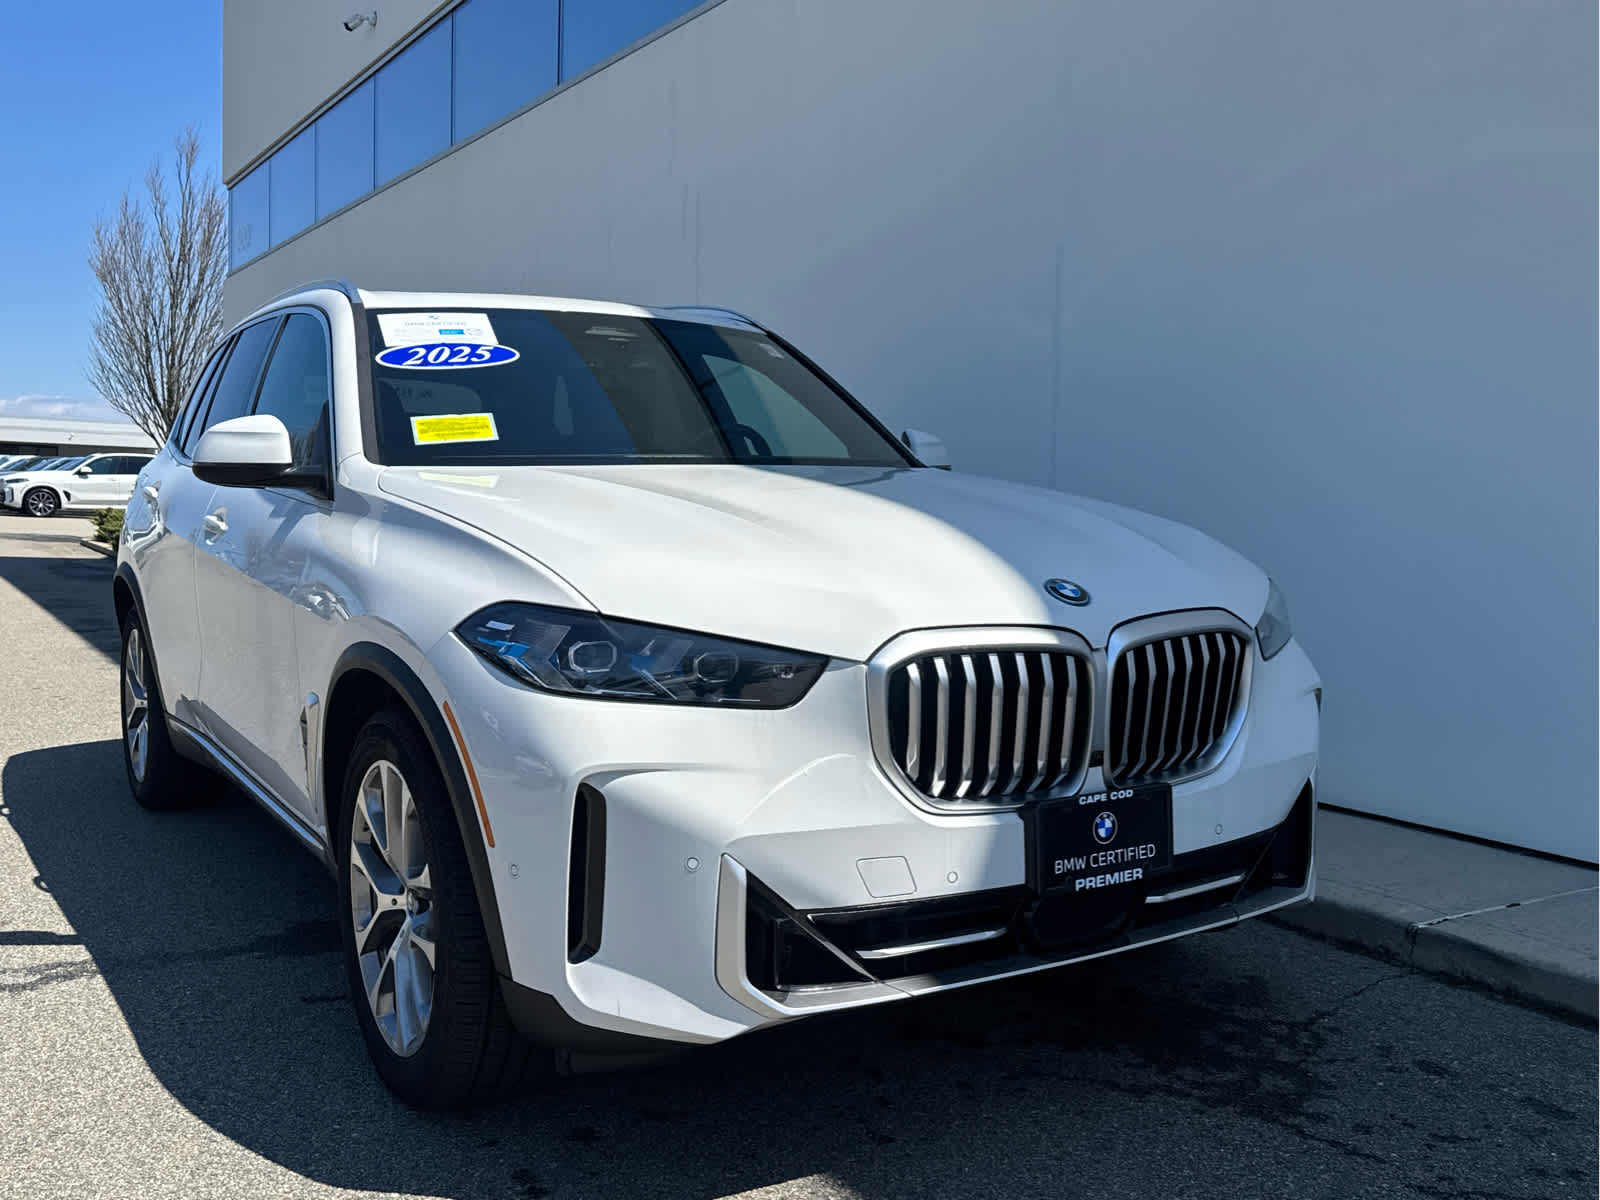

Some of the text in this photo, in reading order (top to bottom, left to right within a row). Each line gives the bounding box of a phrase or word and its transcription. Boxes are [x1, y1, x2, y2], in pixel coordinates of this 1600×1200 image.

[402, 346, 494, 366] 2025
[1079, 789, 1134, 805] CAPE COD
[1054, 843, 1156, 875] BMW CERTIFIED
[1075, 868, 1143, 892] PREMIER
